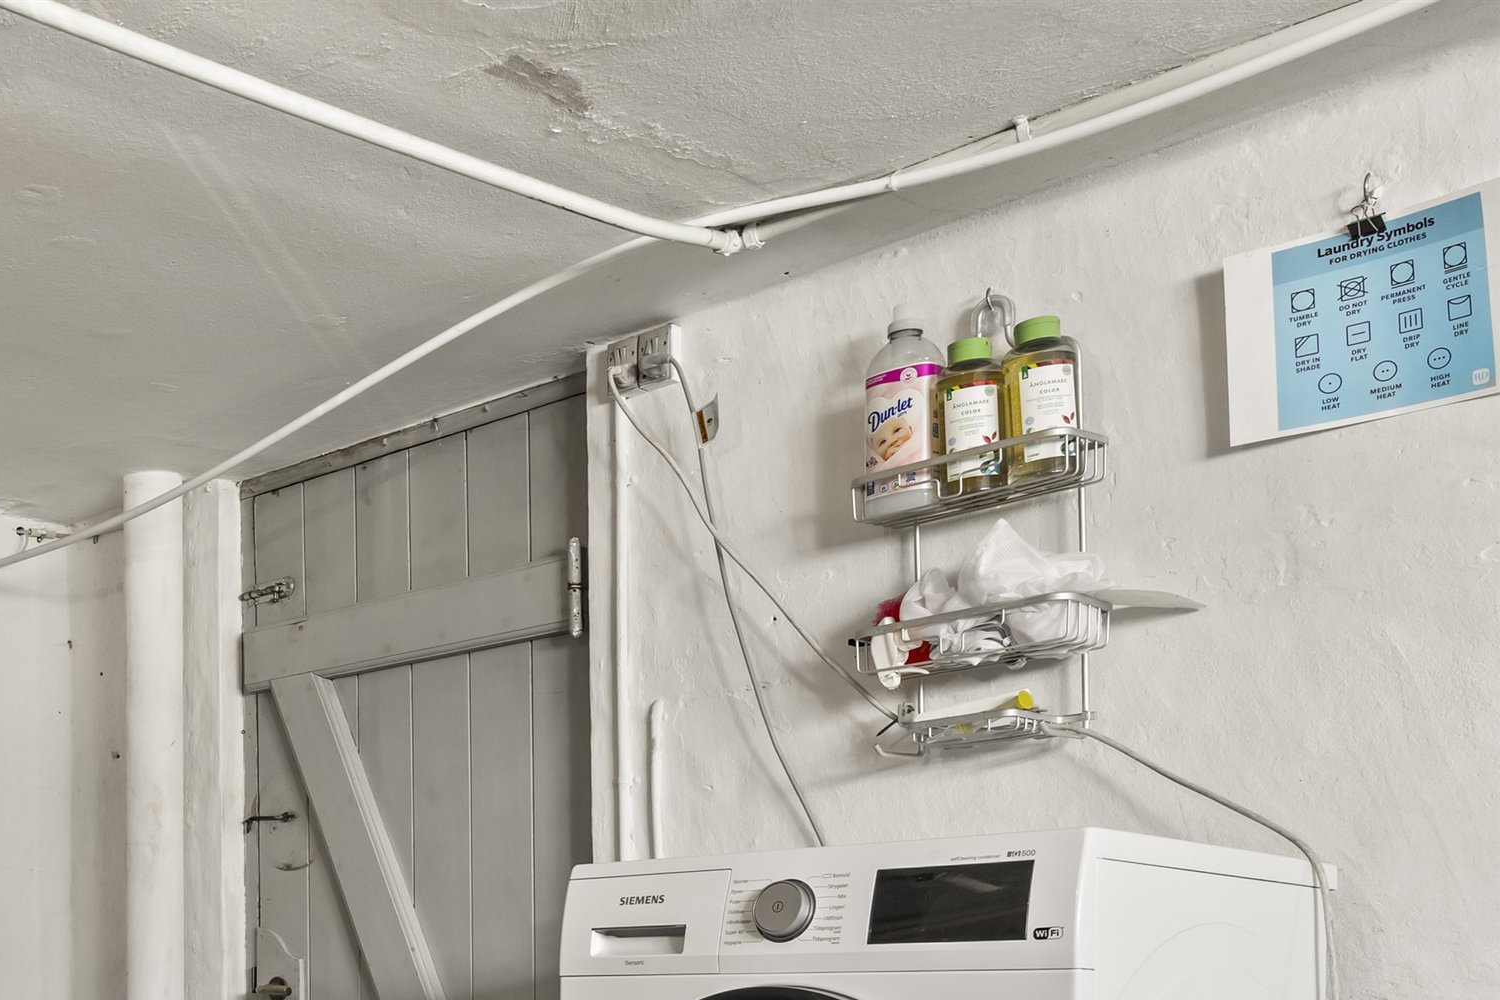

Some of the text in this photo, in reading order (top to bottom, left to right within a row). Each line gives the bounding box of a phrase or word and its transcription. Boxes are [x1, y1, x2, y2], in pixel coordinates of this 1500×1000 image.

[1317, 216, 1435, 259] Laundry Symbols
[1329, 232, 1428, 265] FOR DRYING CLOTHES
[1442, 272, 1471, 285] GENTLE
[1446, 280, 1469, 291] CYCLE
[1380, 284, 1426, 301] PERMANENT
[1392, 294, 1416, 305] PRESS
[1352, 300, 1368, 309] NOT
[1346, 308, 1361, 317] DRY
[1289, 312, 1319, 323] TUMBLE
[1297, 320, 1312, 328] DRY
[1453, 321, 1469, 330] LINE
[1454, 329, 1469, 337] DRY
[1402, 334, 1421, 343] DRIP
[1404, 341, 1420, 350] DRY
[1351, 347, 1367, 356] DRY
[1295, 358, 1311, 367] DRY
[1351, 354, 1368, 362] FLAT
[1295, 364, 1321, 373] SHADE
[1430, 373, 1451, 382] HIGH
[1370, 383, 1402, 395] MEDIUM
[1431, 380, 1451, 389] HEAT
[1376, 391, 1397, 400] HEAT
[1322, 397, 1339, 405] LOW
[1321, 403, 1341, 411] HEAT
[867, 397, 913, 433] Dun-let
[961, 408, 981, 416] COLOR
[619, 895, 665, 906] SIEMENS
